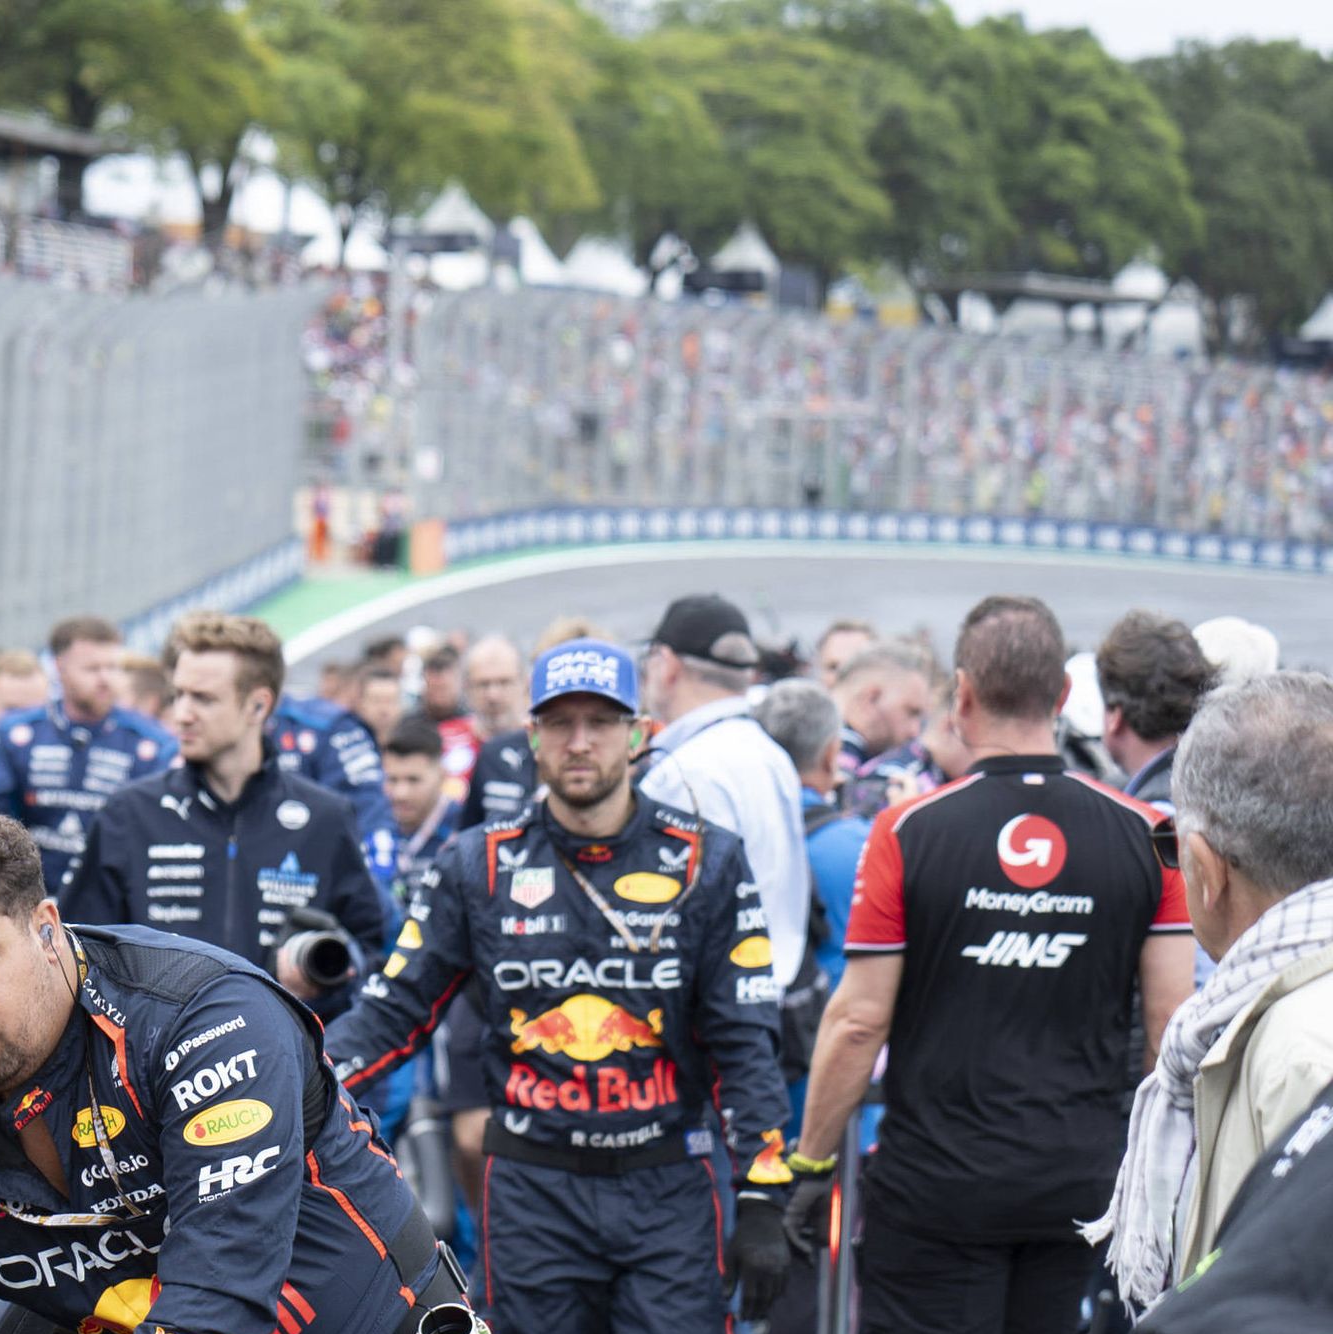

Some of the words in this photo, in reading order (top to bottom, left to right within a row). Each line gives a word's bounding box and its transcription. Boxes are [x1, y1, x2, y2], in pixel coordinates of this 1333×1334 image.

[965, 887, 1095, 917] MoneyGram
[493, 957, 683, 991] ORACLE
[170, 1048, 259, 1112] ROKT
[207, 1107, 263, 1135] RAUCH
[197, 1145, 281, 1197] HRC
